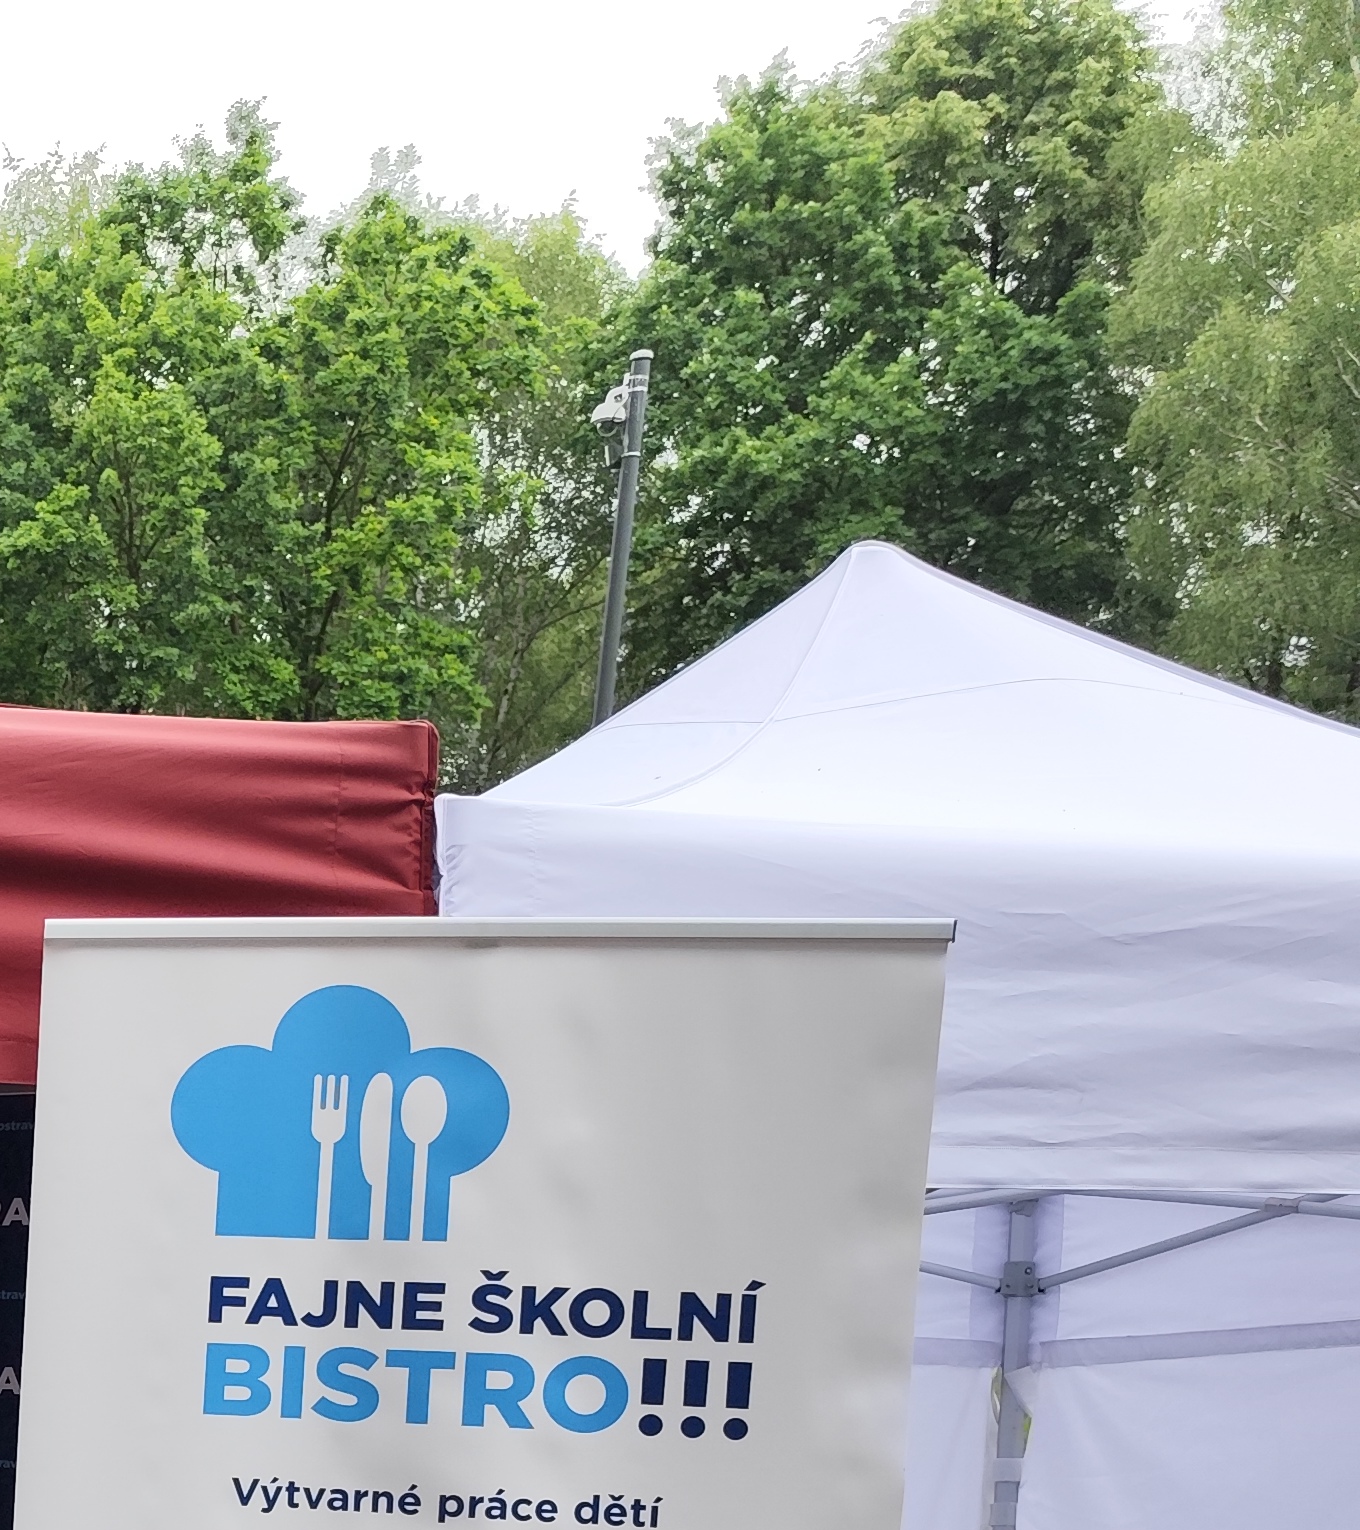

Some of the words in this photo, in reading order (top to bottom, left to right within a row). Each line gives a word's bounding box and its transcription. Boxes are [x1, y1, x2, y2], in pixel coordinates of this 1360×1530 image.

[208, 1275, 447, 1332] FAJNE
[468, 1270, 766, 1345] ŠKOLNÍ
[202, 1342, 754, 1441] BISTRO!!!
[232, 1477, 422, 1517] Výtvarné
[437, 1486, 559, 1527] práce
[574, 1495, 665, 1529] dětí
